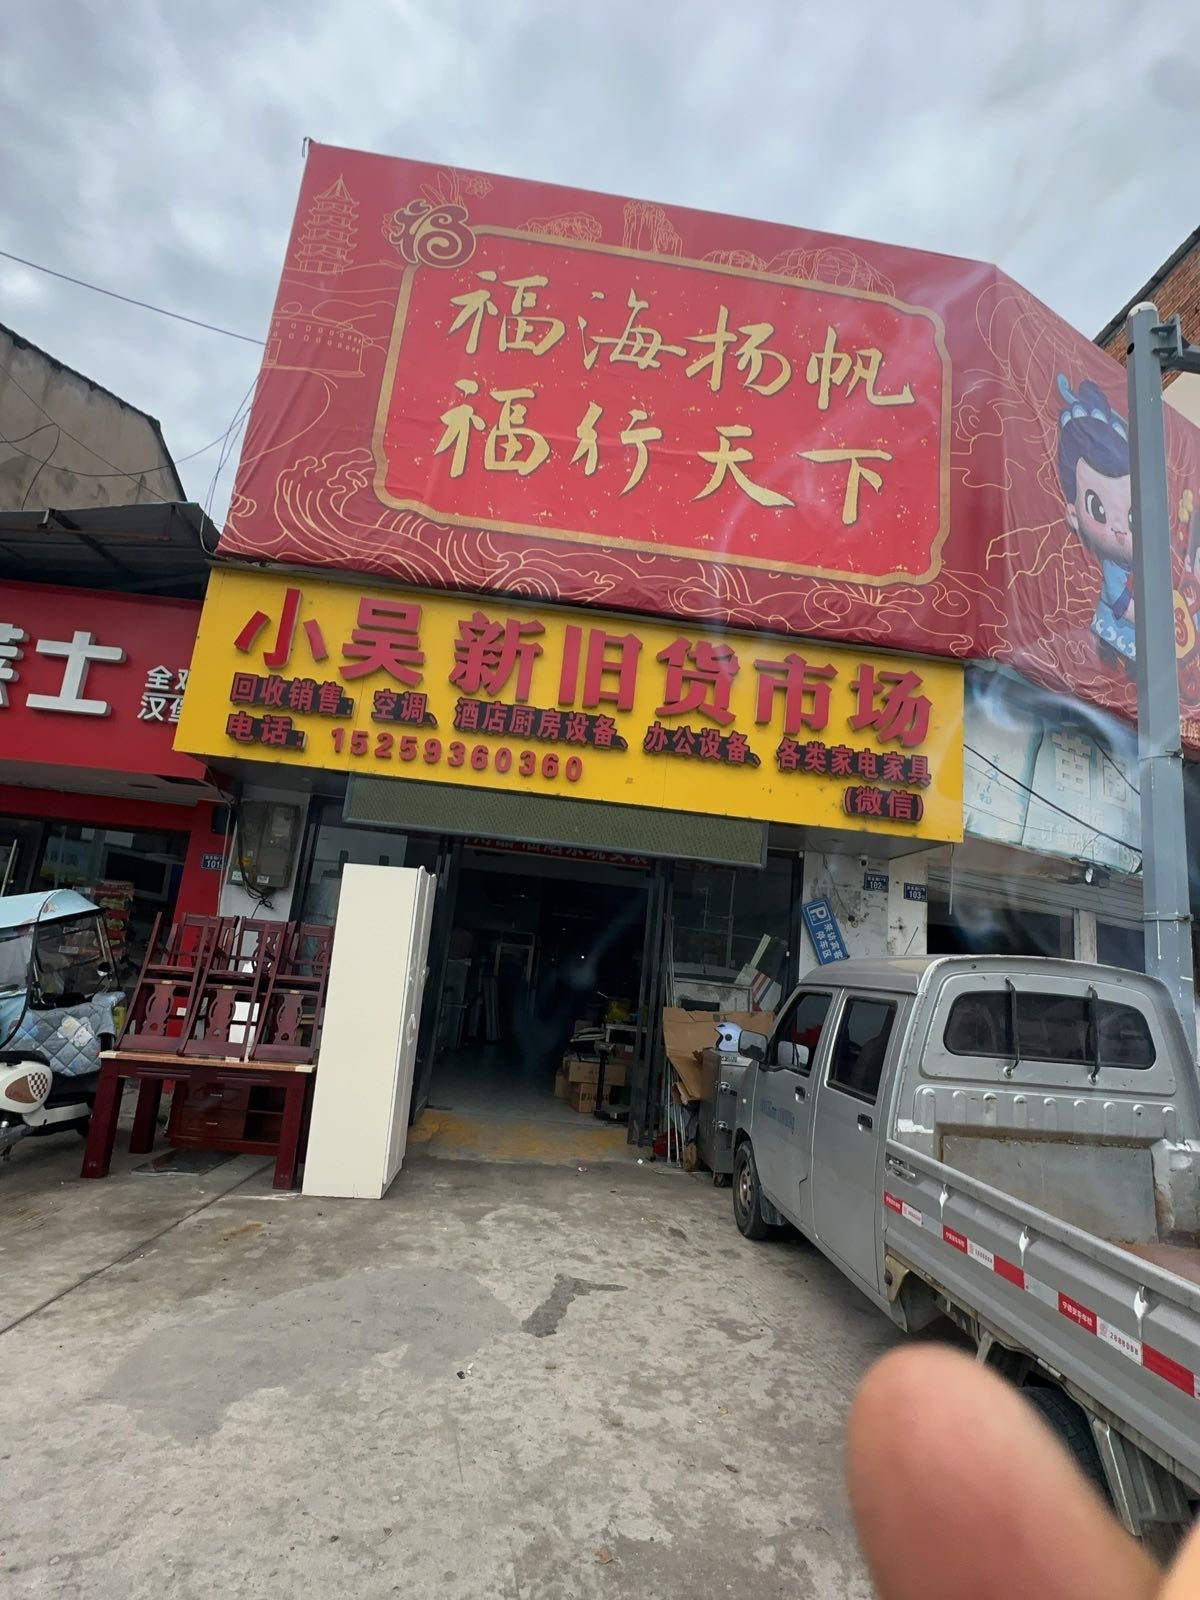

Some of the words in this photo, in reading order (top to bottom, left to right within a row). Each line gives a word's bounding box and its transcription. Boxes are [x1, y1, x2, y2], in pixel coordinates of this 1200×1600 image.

[448, 270, 914, 411] 福海扬帆
[433, 379, 890, 526] 福行天下
[233, 586, 933, 748] 小吴新旧货市场
[331, 726, 583, 783] 15259360360
[776, 737, 932, 788] 各类家电家具
